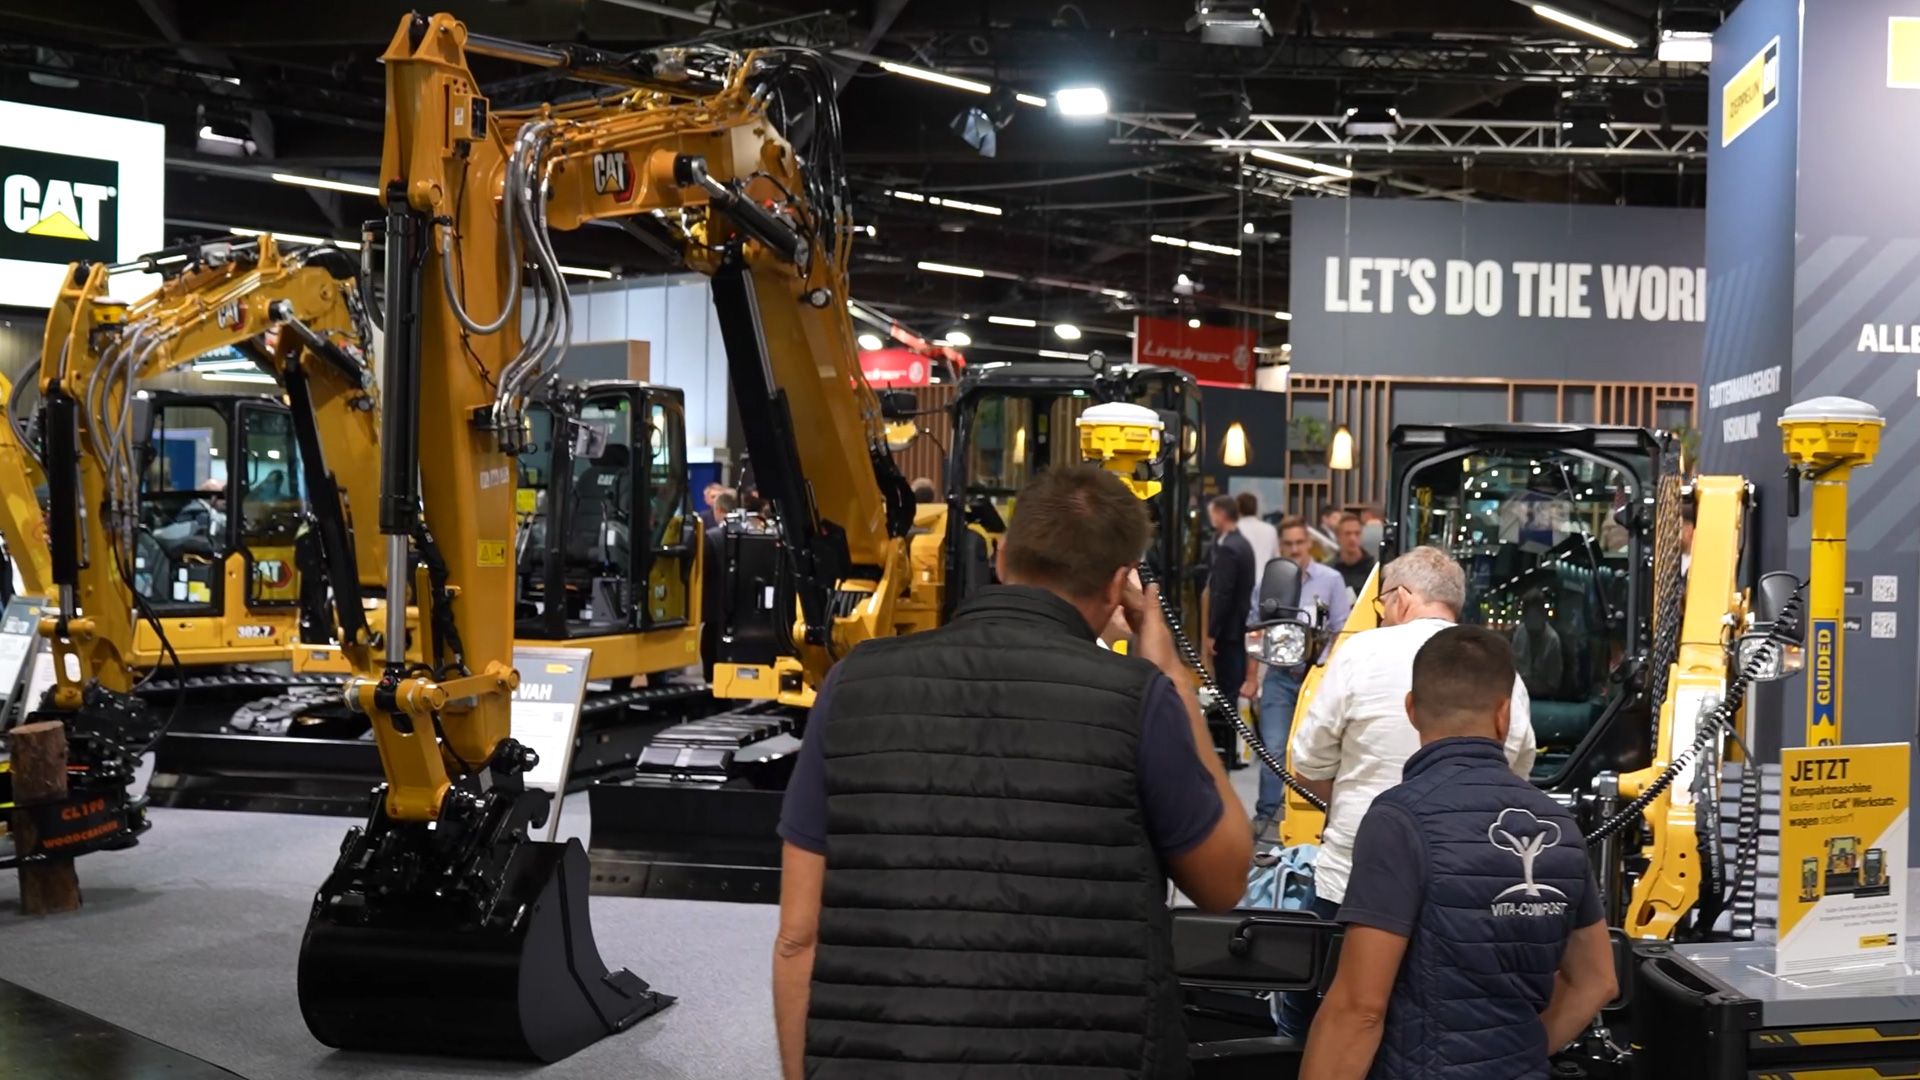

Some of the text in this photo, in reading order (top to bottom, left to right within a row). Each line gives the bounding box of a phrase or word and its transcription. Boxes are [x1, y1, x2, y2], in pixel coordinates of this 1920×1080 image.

[593, 152, 625, 194] CAT
[4, 174, 109, 241] CAT
[1325, 257, 1437, 315] LET'S
[1445, 260, 1503, 317] DO
[1513, 262, 1592, 318] THE
[1142, 340, 1230, 363] Lindner
[237, 625, 270, 638] 302.7
[1816, 629, 1831, 705] GUIDED
[519, 683, 553, 700] VAH
[1790, 758, 1851, 782] JETZT
[1789, 783, 1872, 797] Kompaktmaschine
[61, 798, 105, 820] CL190
[1816, 801, 1831, 810] und
[1789, 817, 1819, 828] wagen
[1491, 902, 1568, 916] VITA-COMPOST
